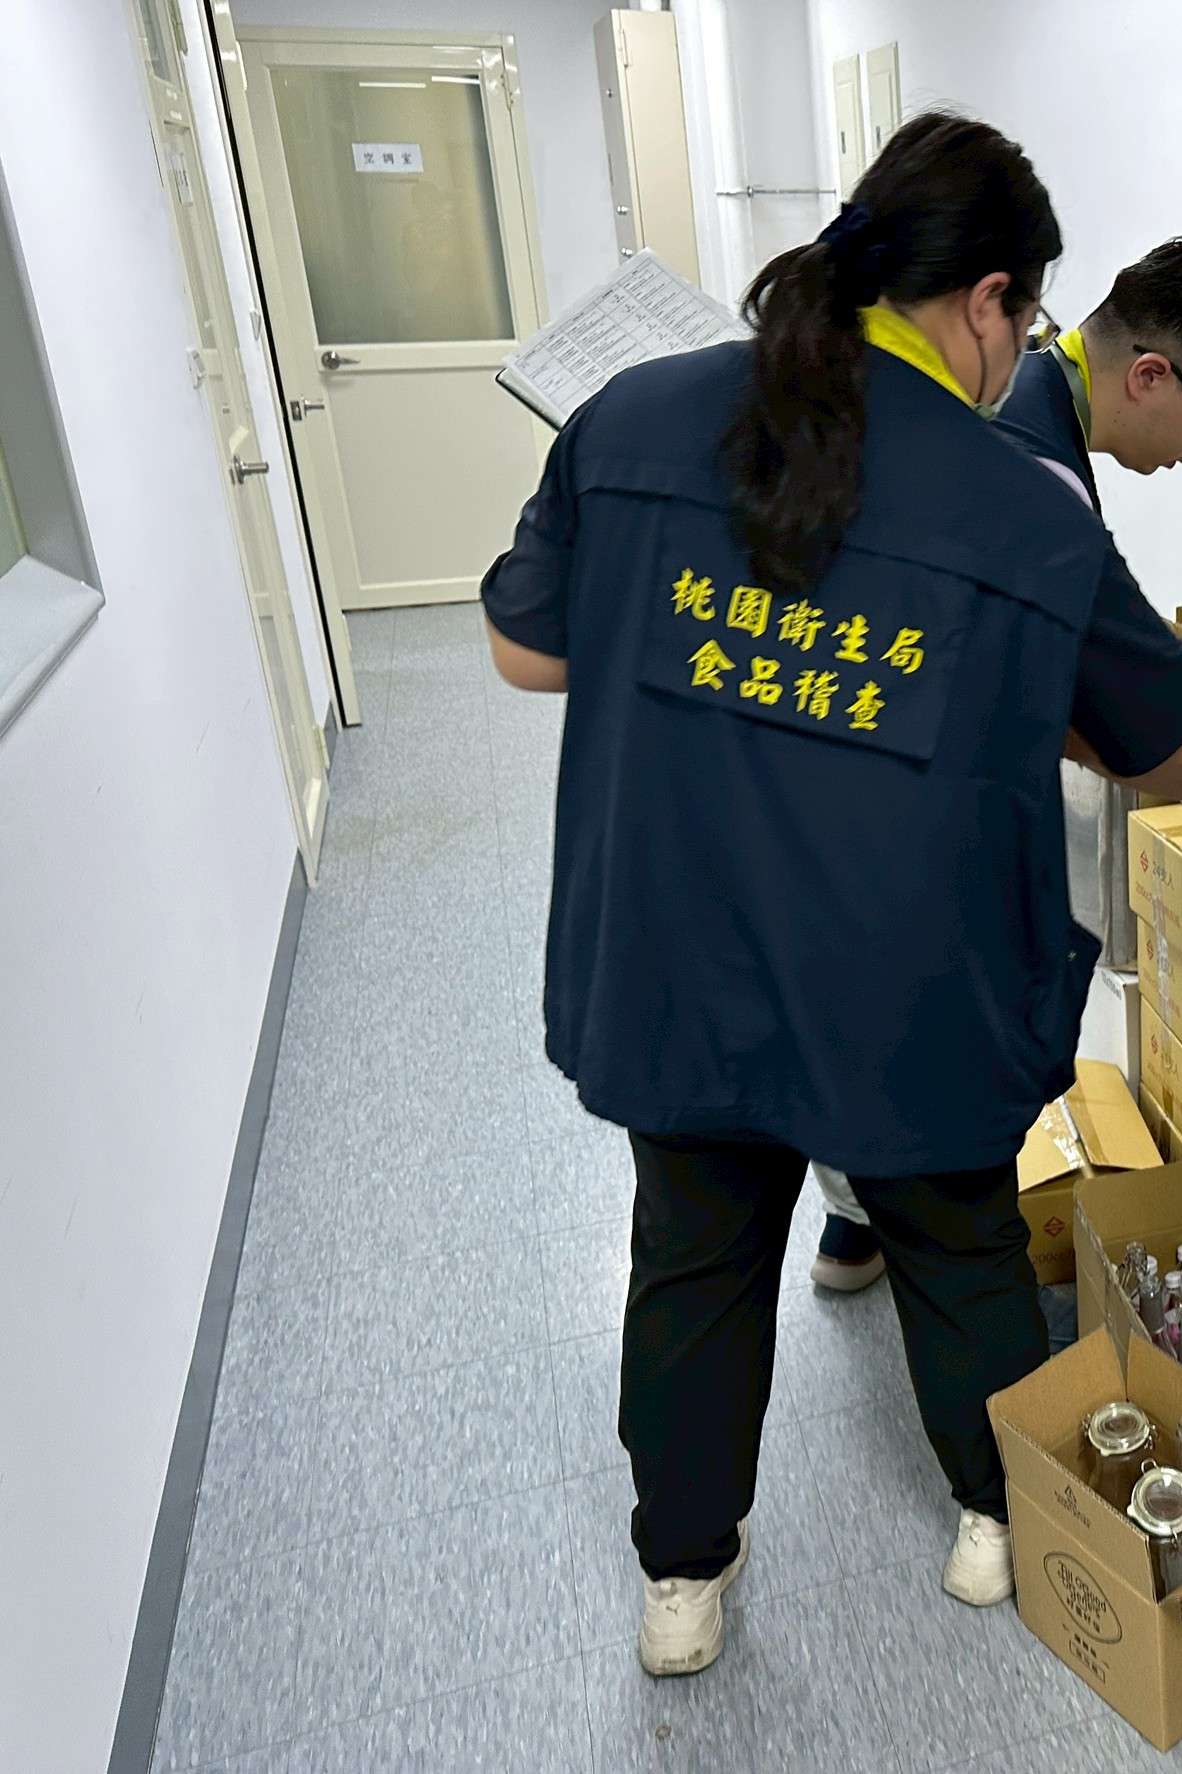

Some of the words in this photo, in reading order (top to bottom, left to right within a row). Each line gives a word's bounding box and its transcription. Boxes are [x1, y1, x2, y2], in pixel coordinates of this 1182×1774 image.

[670, 567, 926, 675] 桃園衛生局
[687, 639, 887, 731] 食品稽查
